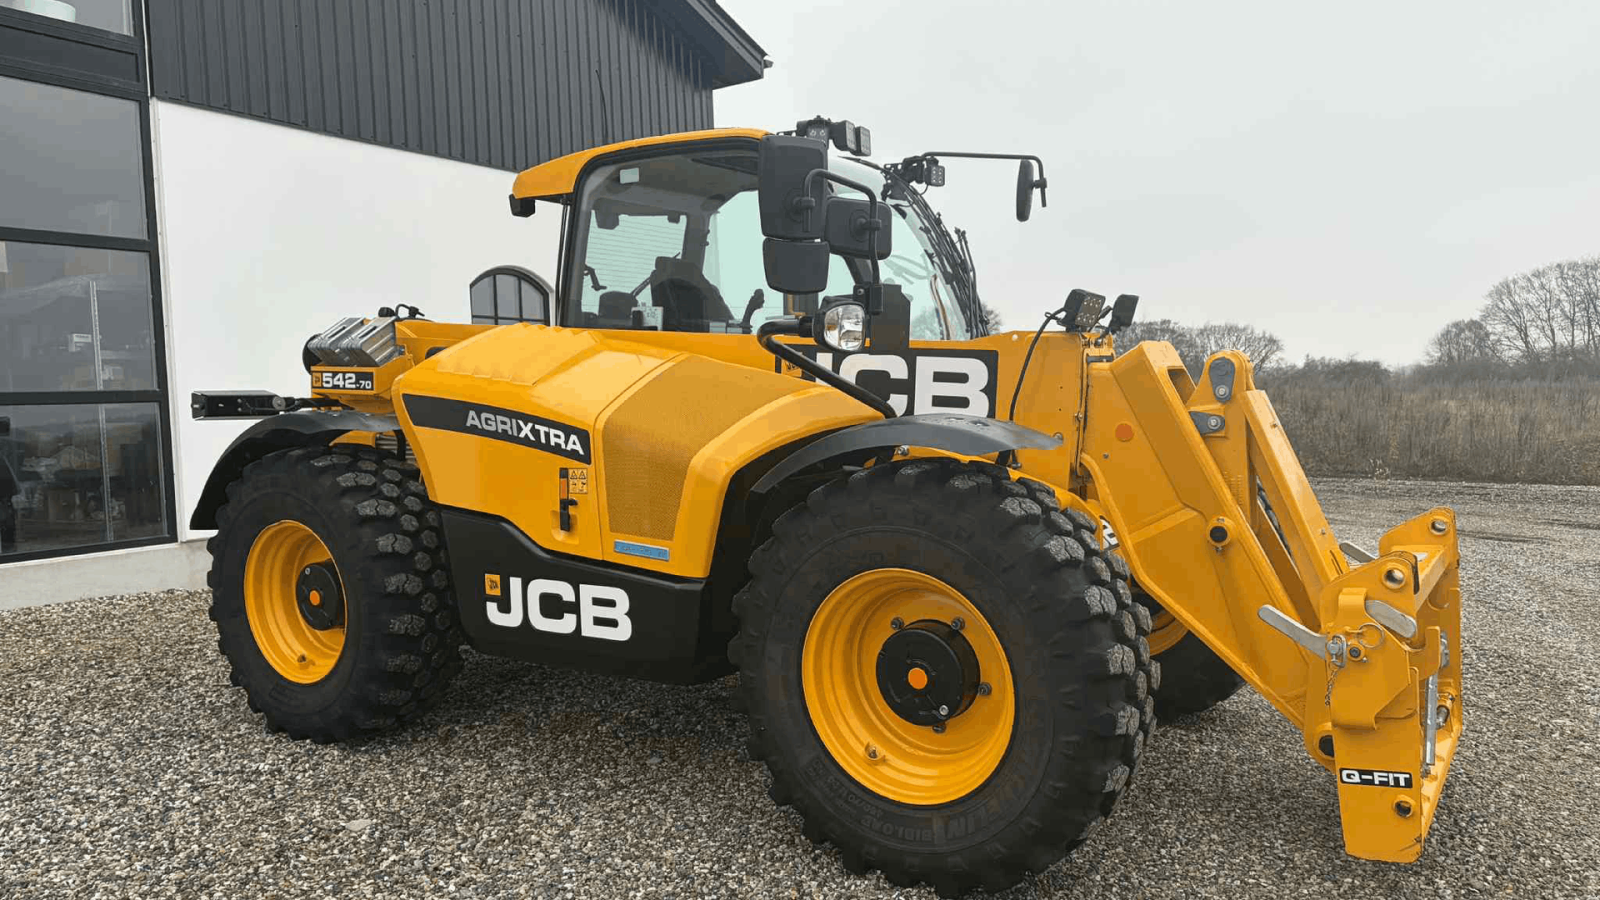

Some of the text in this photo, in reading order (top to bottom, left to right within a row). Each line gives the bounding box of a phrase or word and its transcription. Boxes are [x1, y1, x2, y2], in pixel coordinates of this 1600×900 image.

[322, 372, 372, 389] 542-70
[466, 410, 585, 455] AGRIXTRA
[486, 576, 632, 641] JCB
[1341, 769, 1410, 787] Q-FIT
